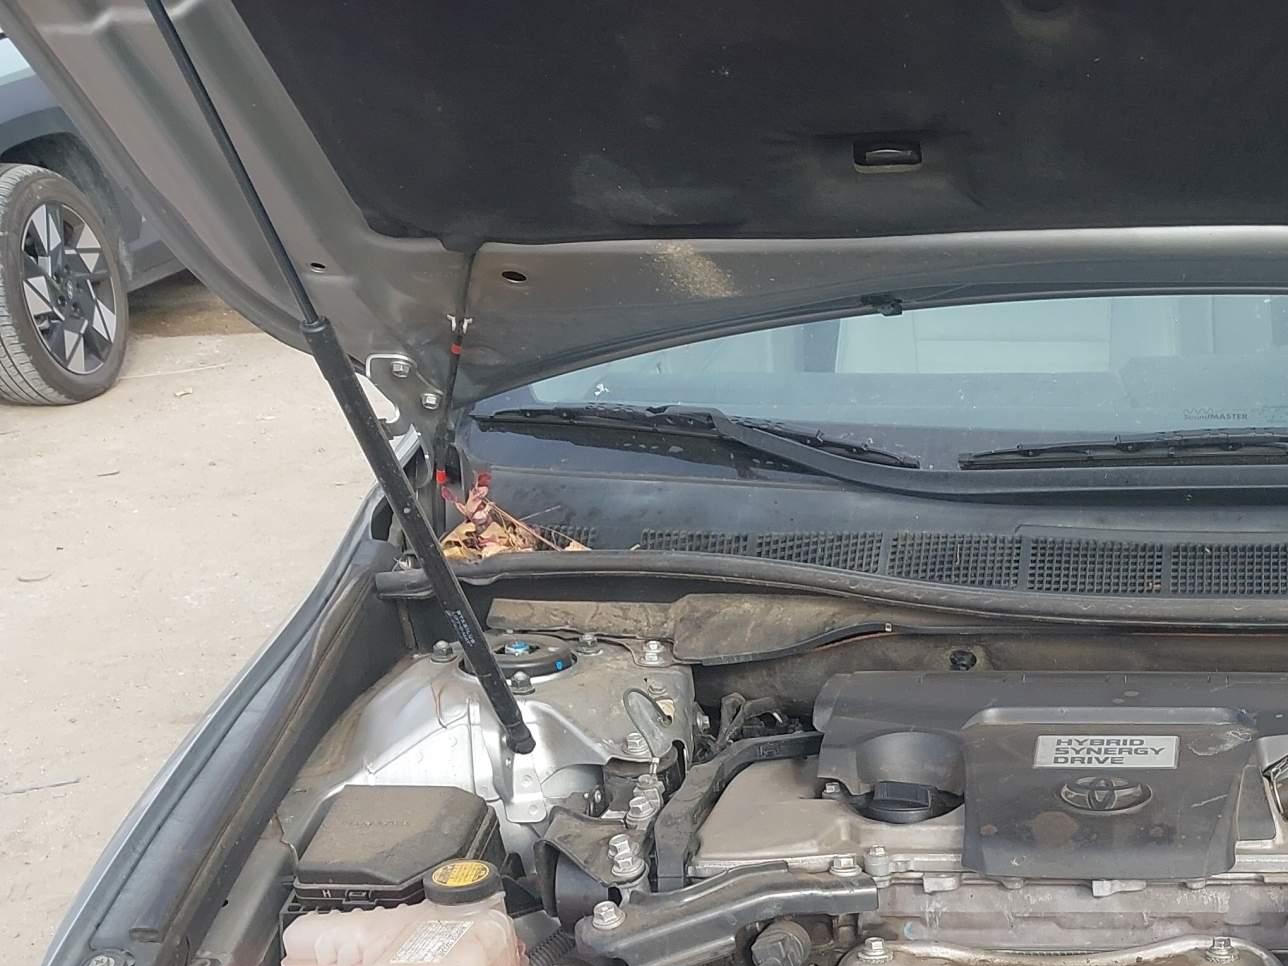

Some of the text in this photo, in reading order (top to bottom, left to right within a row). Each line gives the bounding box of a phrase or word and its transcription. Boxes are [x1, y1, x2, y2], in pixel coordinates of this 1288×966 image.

[1055, 738, 1145, 746] HYBRID
[1054, 747, 1166, 755] SYNERGY
[1052, 756, 1125, 765] DRIVE
